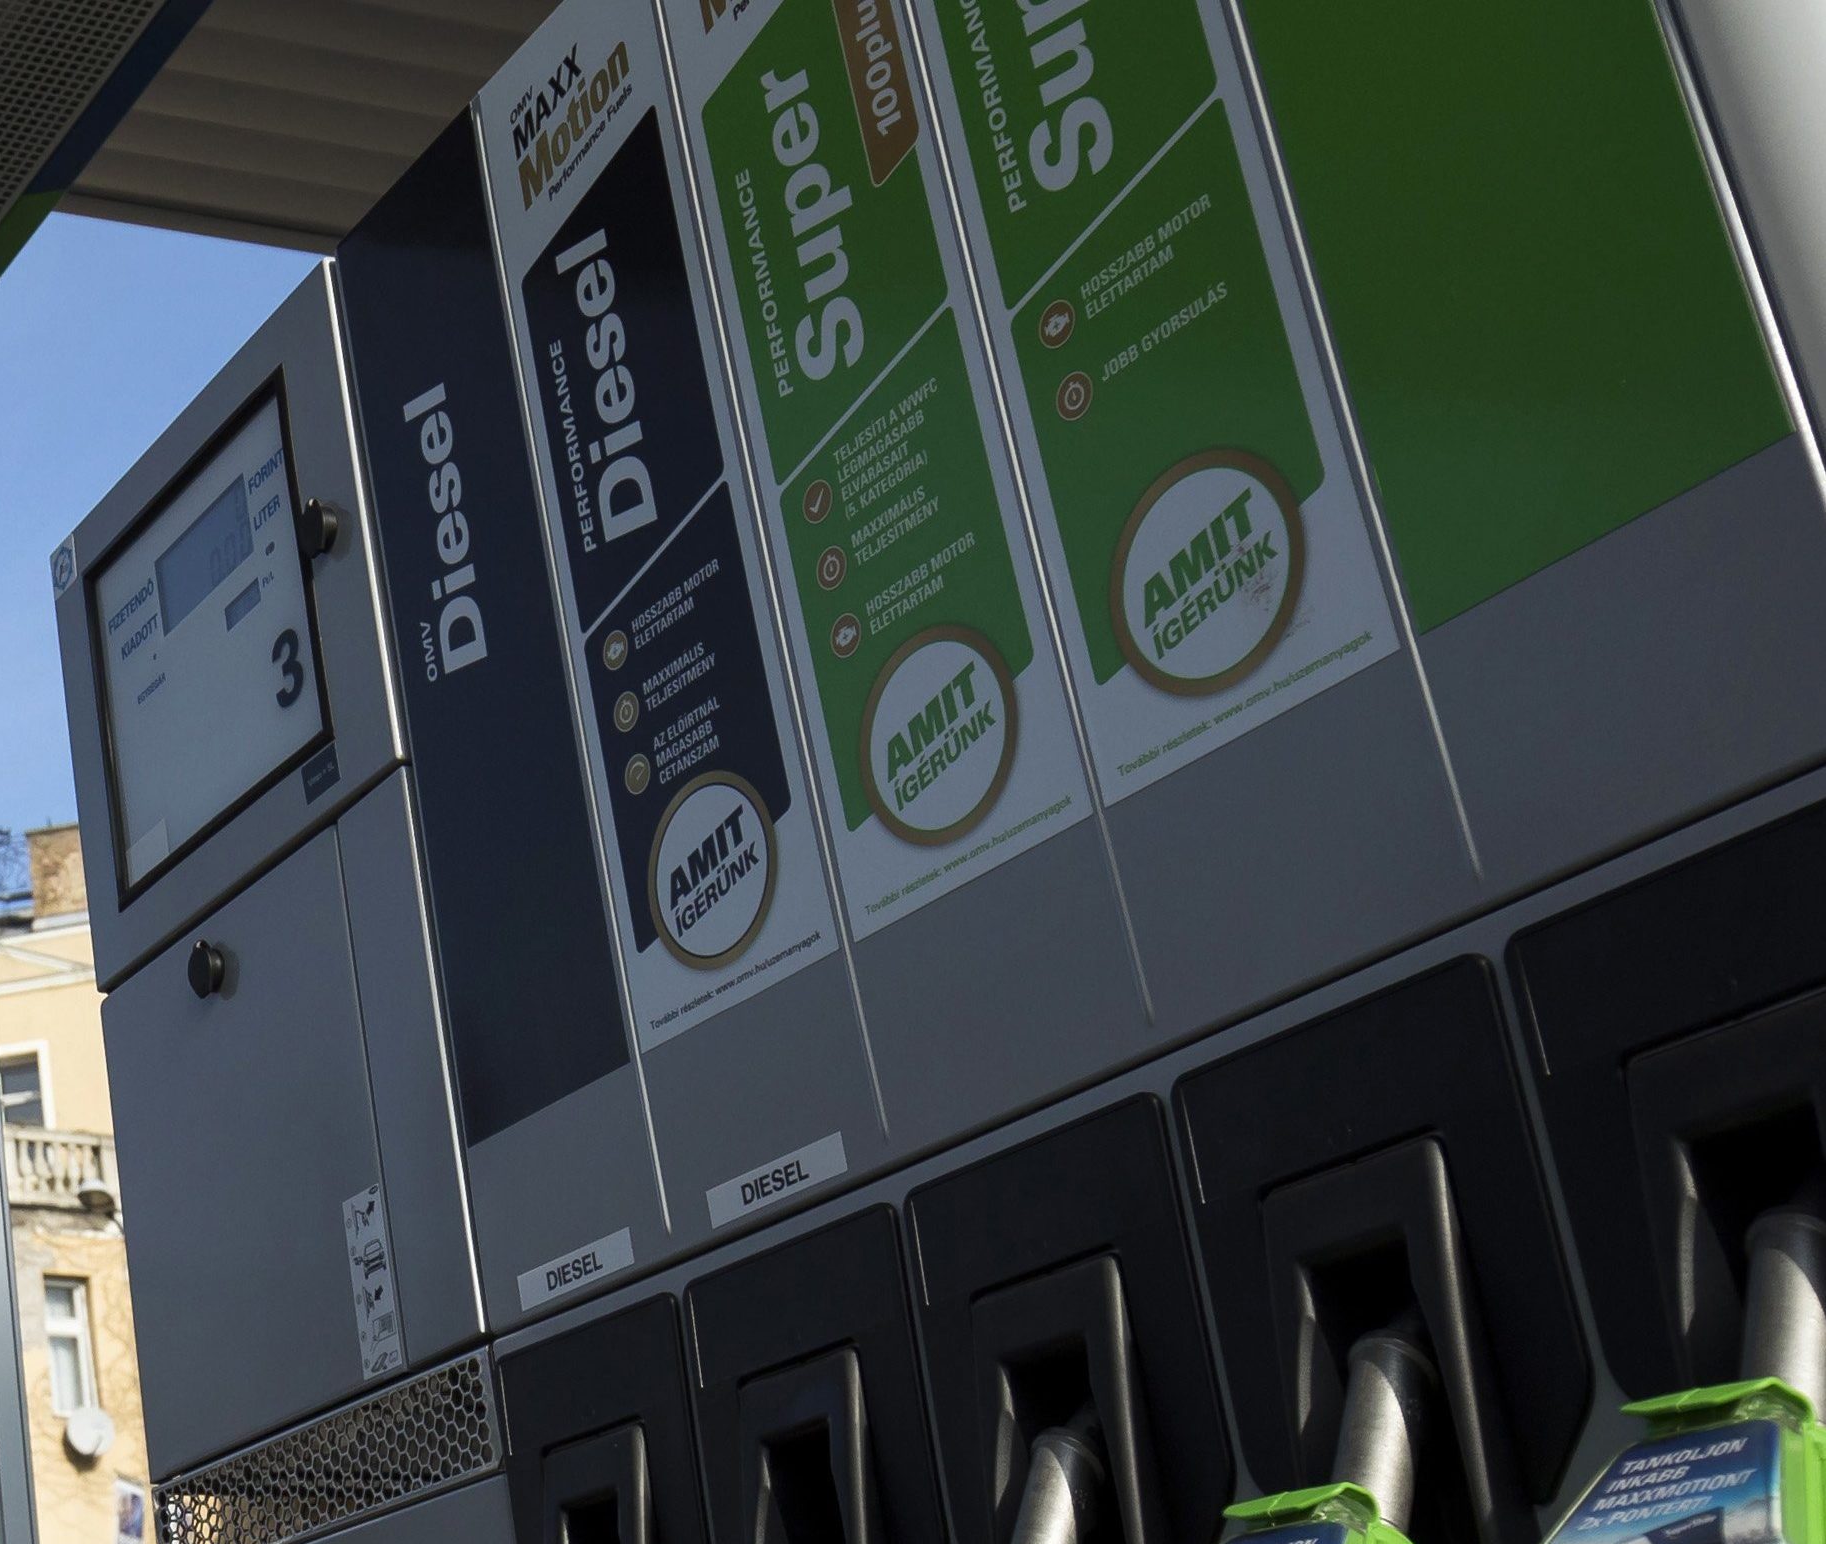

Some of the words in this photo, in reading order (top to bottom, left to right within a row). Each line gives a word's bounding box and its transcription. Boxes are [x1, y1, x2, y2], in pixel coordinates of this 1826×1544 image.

[510, 85, 533, 124] OMV
[511, 43, 582, 161] MAXX
[855, 0, 902, 137] 100plu
[959, 0, 1027, 214] PERFORMANC
[518, 41, 630, 212] Motion
[547, 119, 606, 202] Performance
[760, 69, 865, 381] Super
[1080, 234, 1156, 299] HOSSZABB
[1157, 193, 1212, 243] MOTOR
[735, 169, 794, 398] PERFORMANCE
[556, 228, 658, 542] Diesel
[1101, 344, 1139, 382] JOBB
[247, 447, 285, 495] FORINT
[549, 339, 596, 553] PERFORMANCE
[837, 410, 925, 484] LEGMAGASABB
[253, 493, 281, 532] LITER
[403, 382, 488, 675] Diesel
[631, 586, 682, 633] HOSSZABB
[683, 558, 720, 594] MOTOR
[865, 563, 929, 617] HOSSZABB
[930, 531, 976, 573] MOTOR
[1144, 487, 1252, 629] AMIT
[1152, 530, 1278, 660] ÍGÉRÜNK
[121, 612, 158, 661] KIADOTT
[271, 628, 305, 709] 3
[419, 620, 438, 683] OMV
[653, 731, 667, 751] AZ
[655, 720, 713, 768] MAGASABB
[887, 660, 976, 783] AMIT
[894, 700, 997, 812] ÍGÉRÜNK
[670, 804, 744, 911] AMIT
[674, 841, 760, 938] ÍGÉRÜNK
[741, 1160, 810, 1206] DIESEL
[545, 1251, 603, 1292] DIESEL
[1593, 1468, 1758, 1512] MAXXMOTIONT
[1621, 1437, 1749, 1474] TANKOLJON
